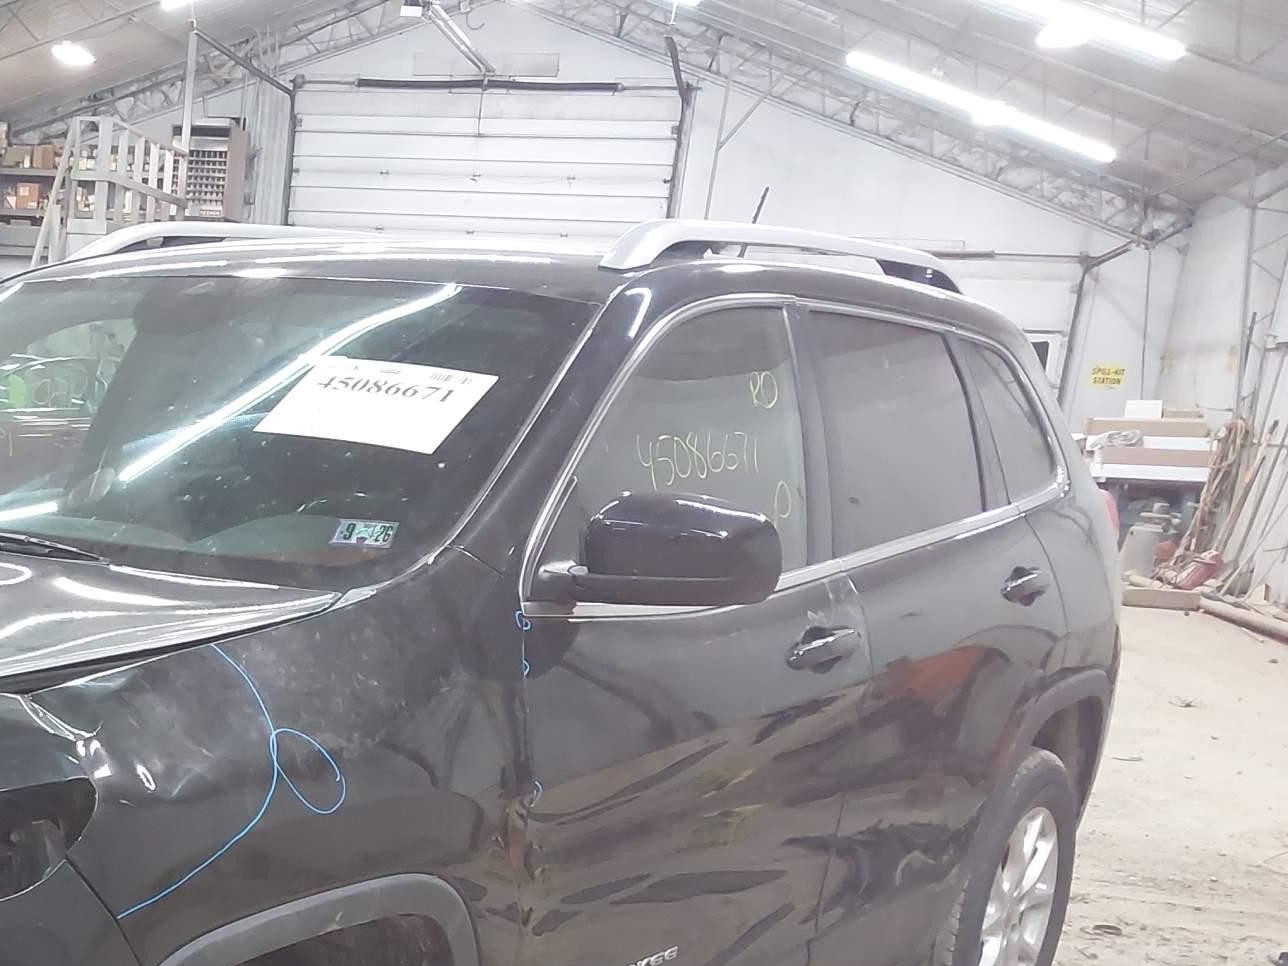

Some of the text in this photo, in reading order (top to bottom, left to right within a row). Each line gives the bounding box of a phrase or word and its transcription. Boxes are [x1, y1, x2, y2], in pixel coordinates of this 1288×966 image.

[316, 375, 456, 403] 45086671
[1092, 376, 1121, 386] STATION
[636, 431, 760, 491] 45086671
[343, 523, 394, 542] 9 26
